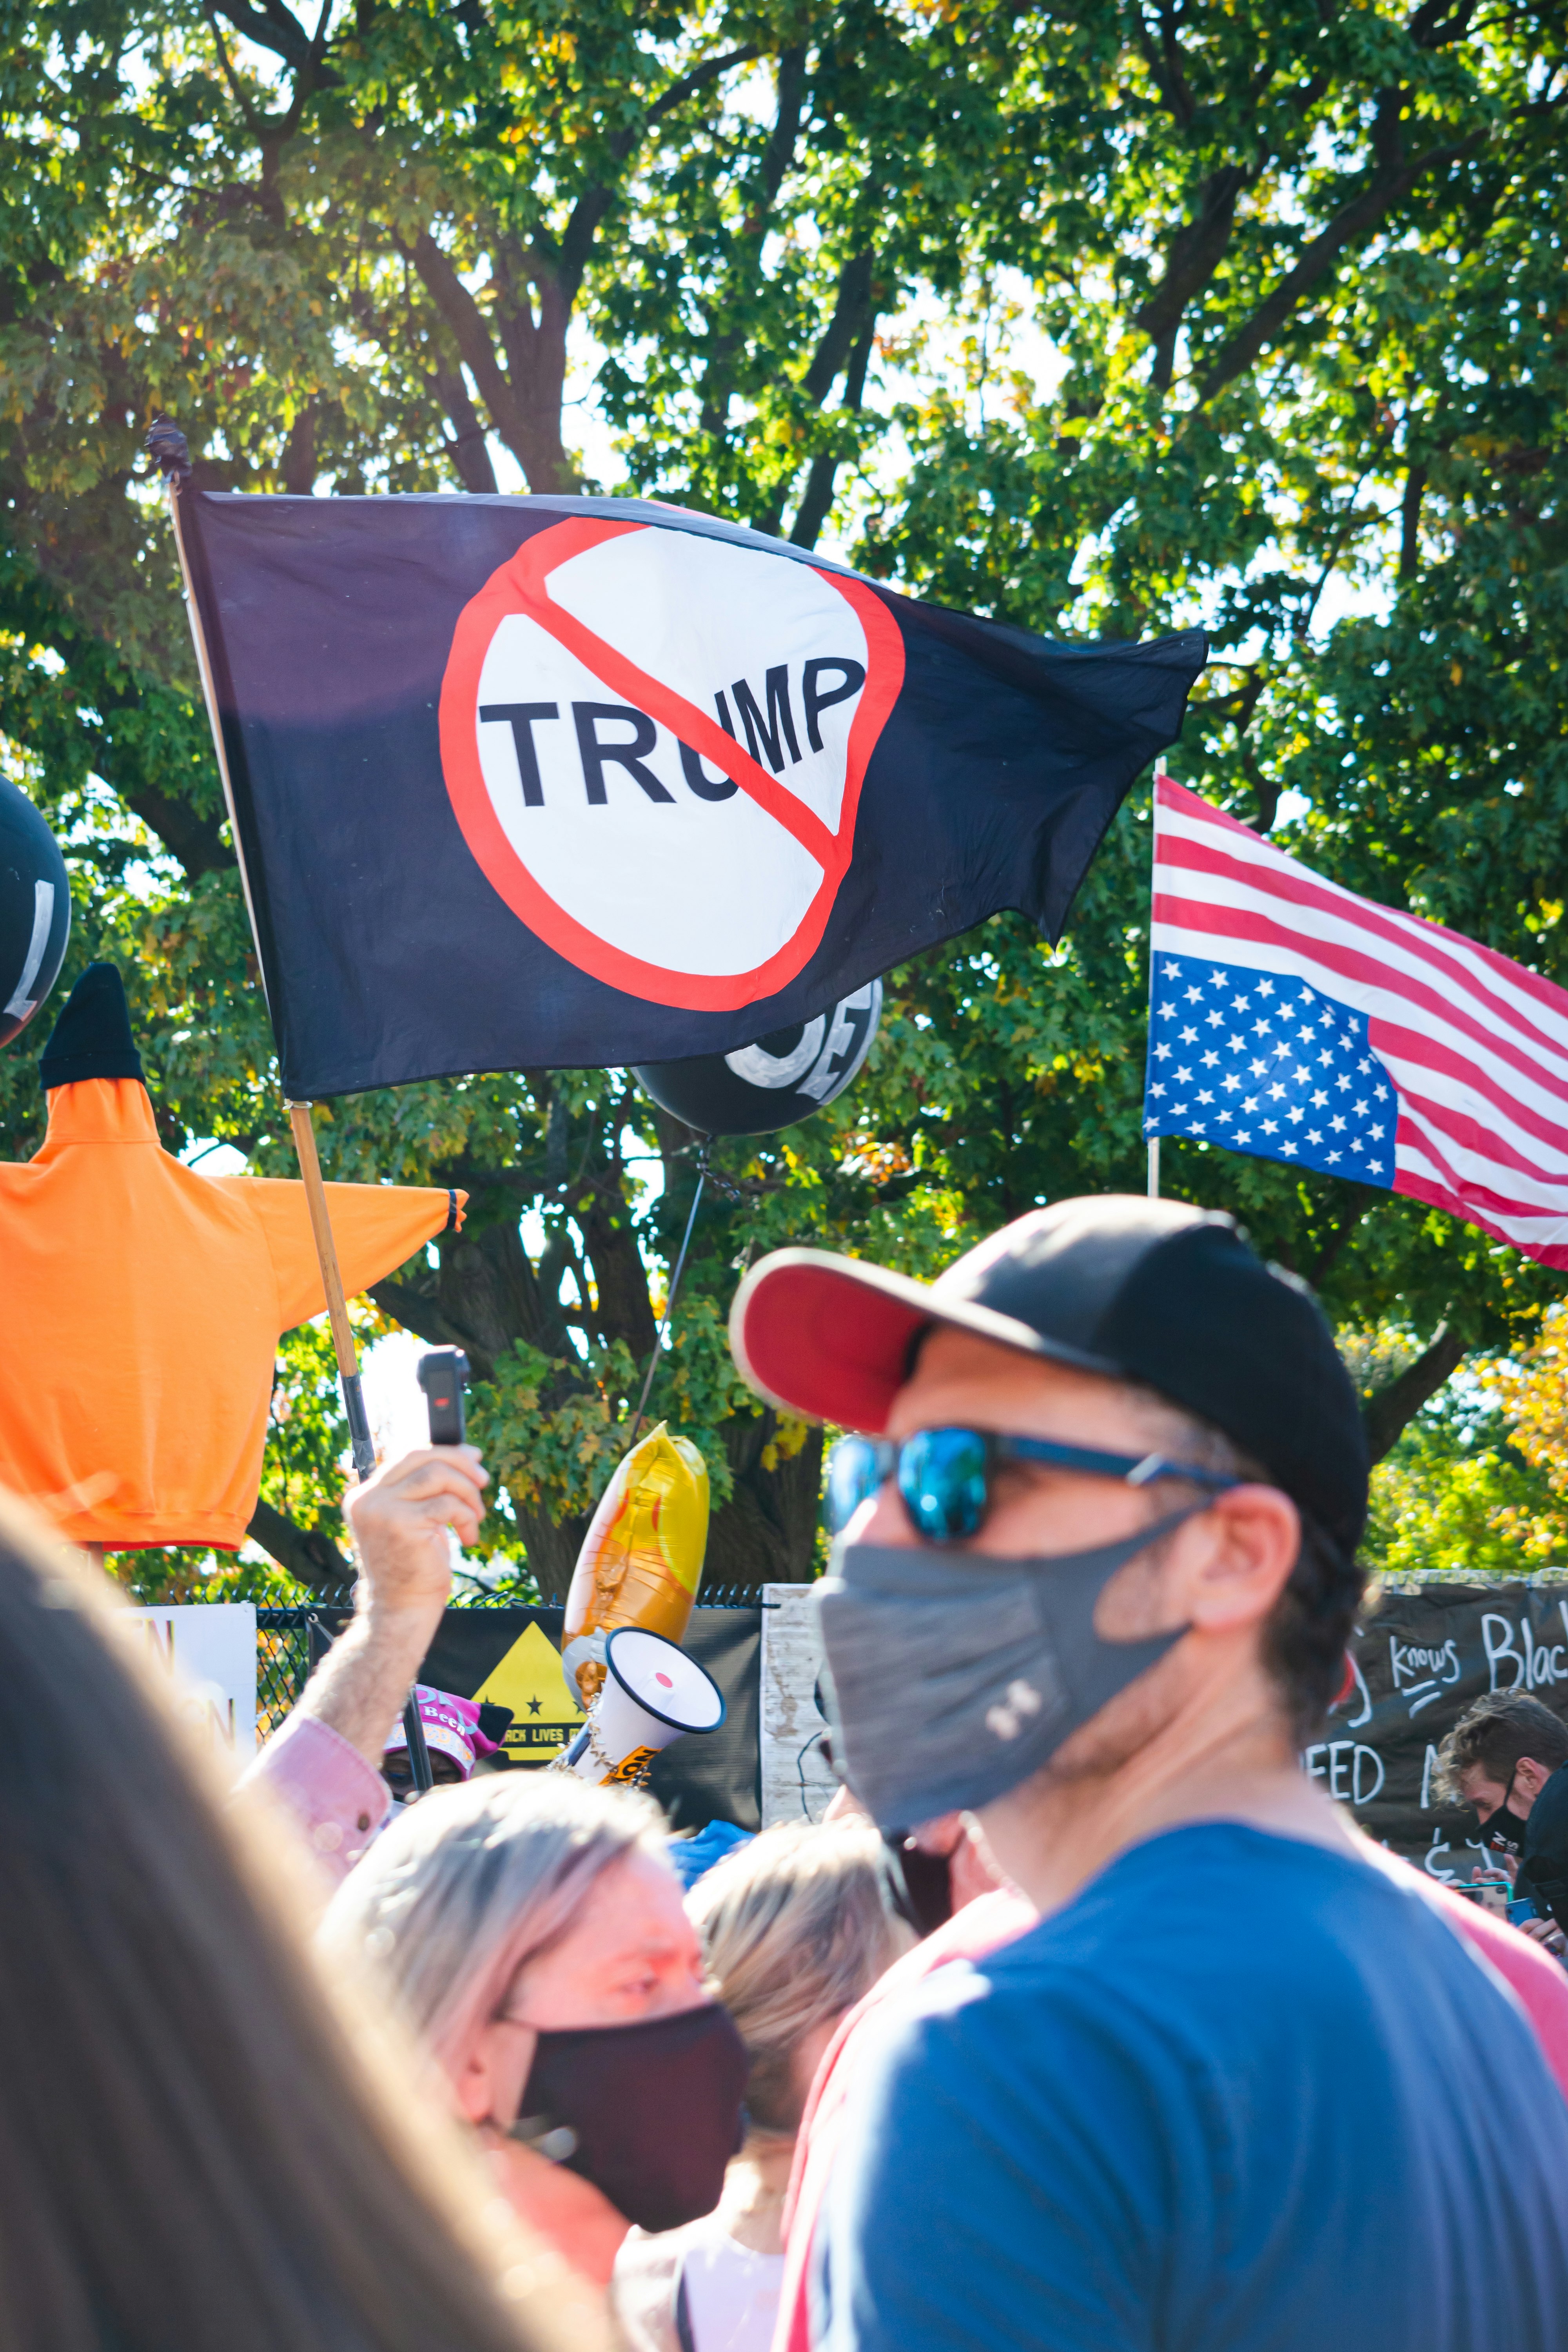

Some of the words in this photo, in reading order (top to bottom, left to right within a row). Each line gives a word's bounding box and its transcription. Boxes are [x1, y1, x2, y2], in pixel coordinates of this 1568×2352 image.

[478, 657, 866, 808] TRUMP
[423, 1706, 465, 1737] Been
[532, 1728, 563, 1742] LIVES
[1298, 1740, 1385, 1805] EED
